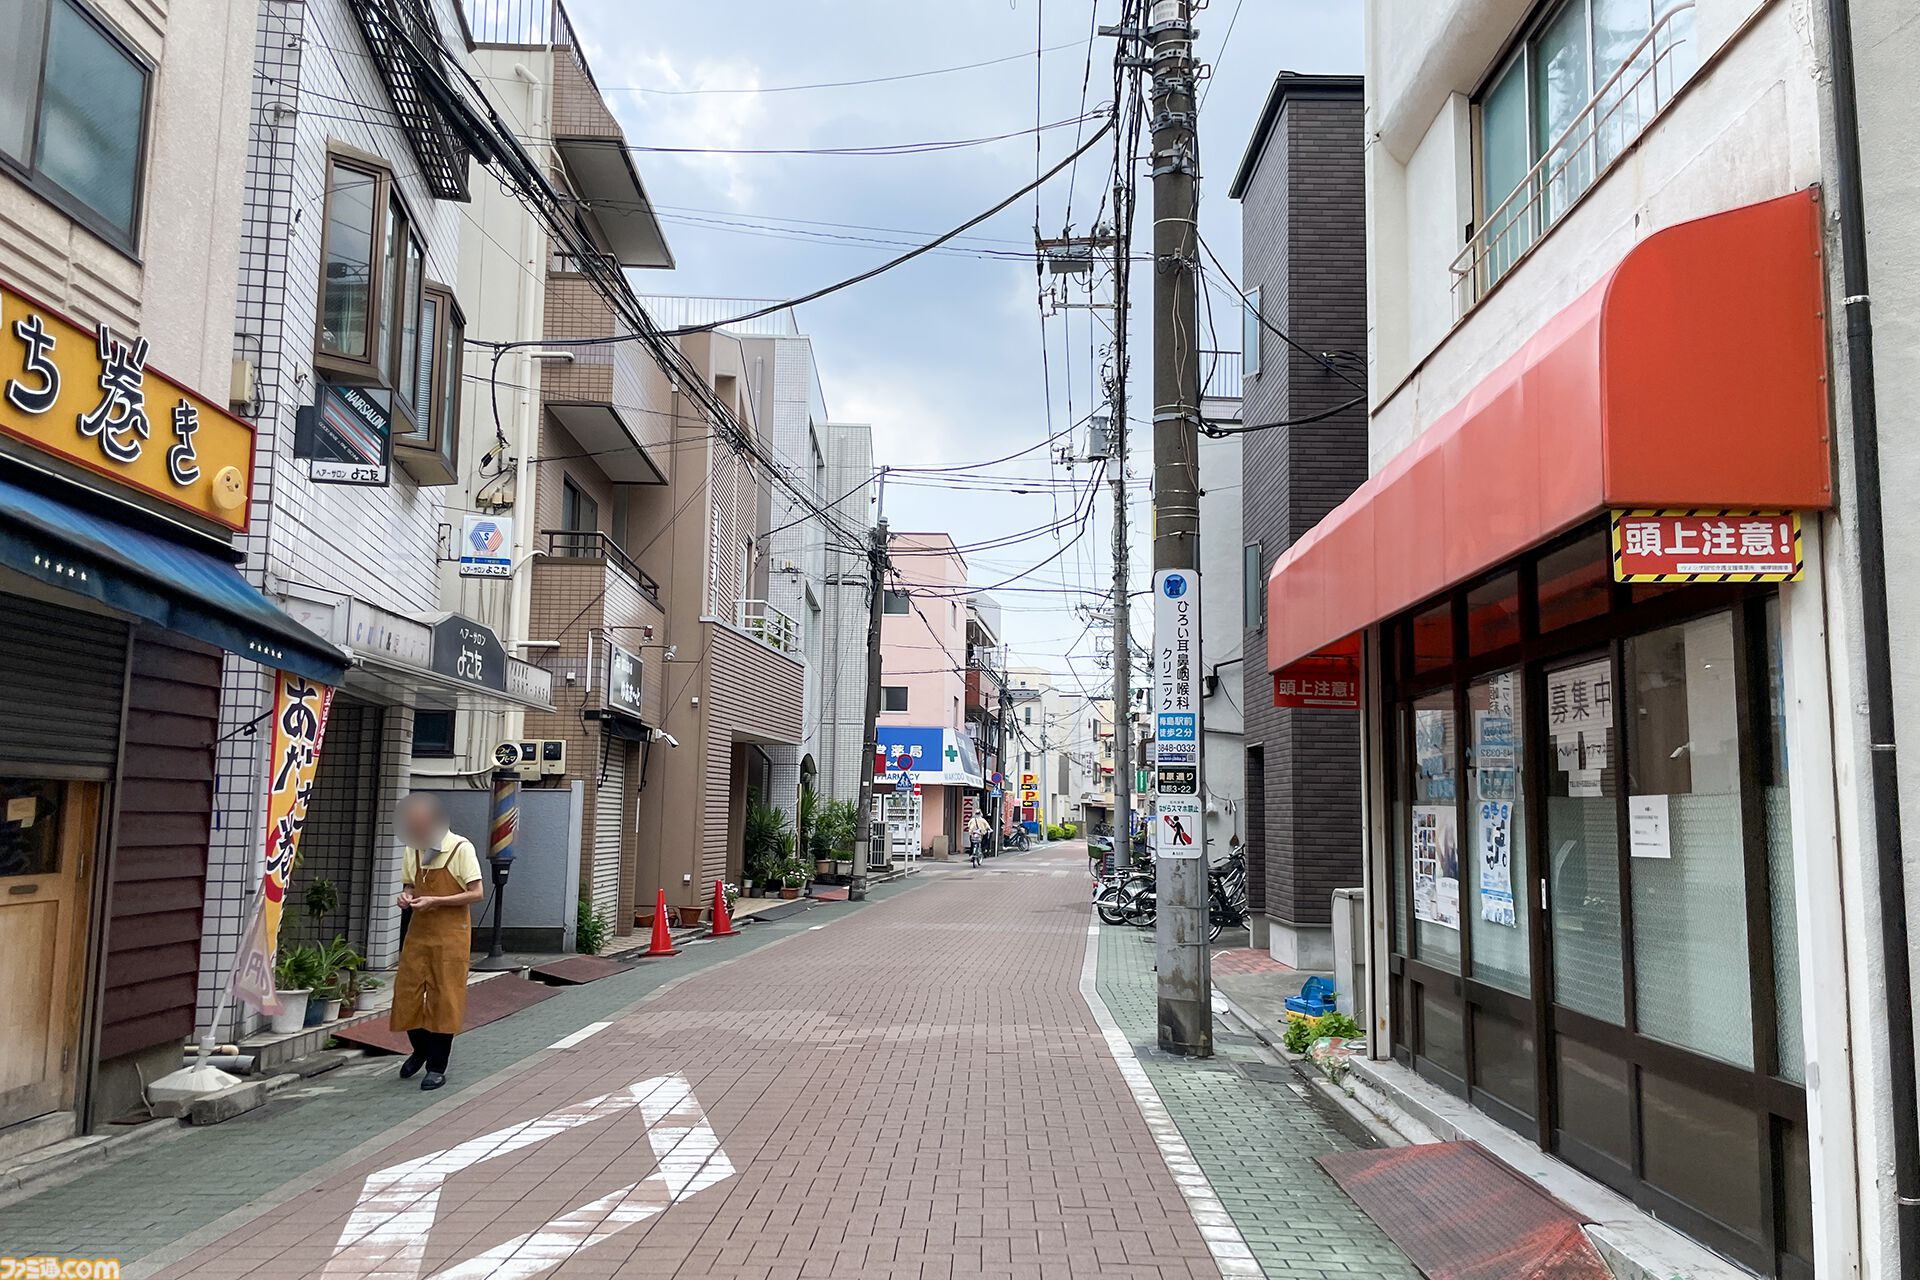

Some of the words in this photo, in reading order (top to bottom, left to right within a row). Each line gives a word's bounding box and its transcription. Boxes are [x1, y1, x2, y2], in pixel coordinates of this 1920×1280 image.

[483, 532, 490, 541] S
[1624, 521, 1791, 557] 頭上注意!
[1176, 600, 1190, 711] ひろい耳鼻咽喉科
[1162, 647, 1173, 711] クリニック
[1279, 679, 1355, 697] 頭上注意!
[1550, 673, 1611, 724] 募集中
[1023, 774, 1034, 784] P
[1025, 791, 1036, 801] P
